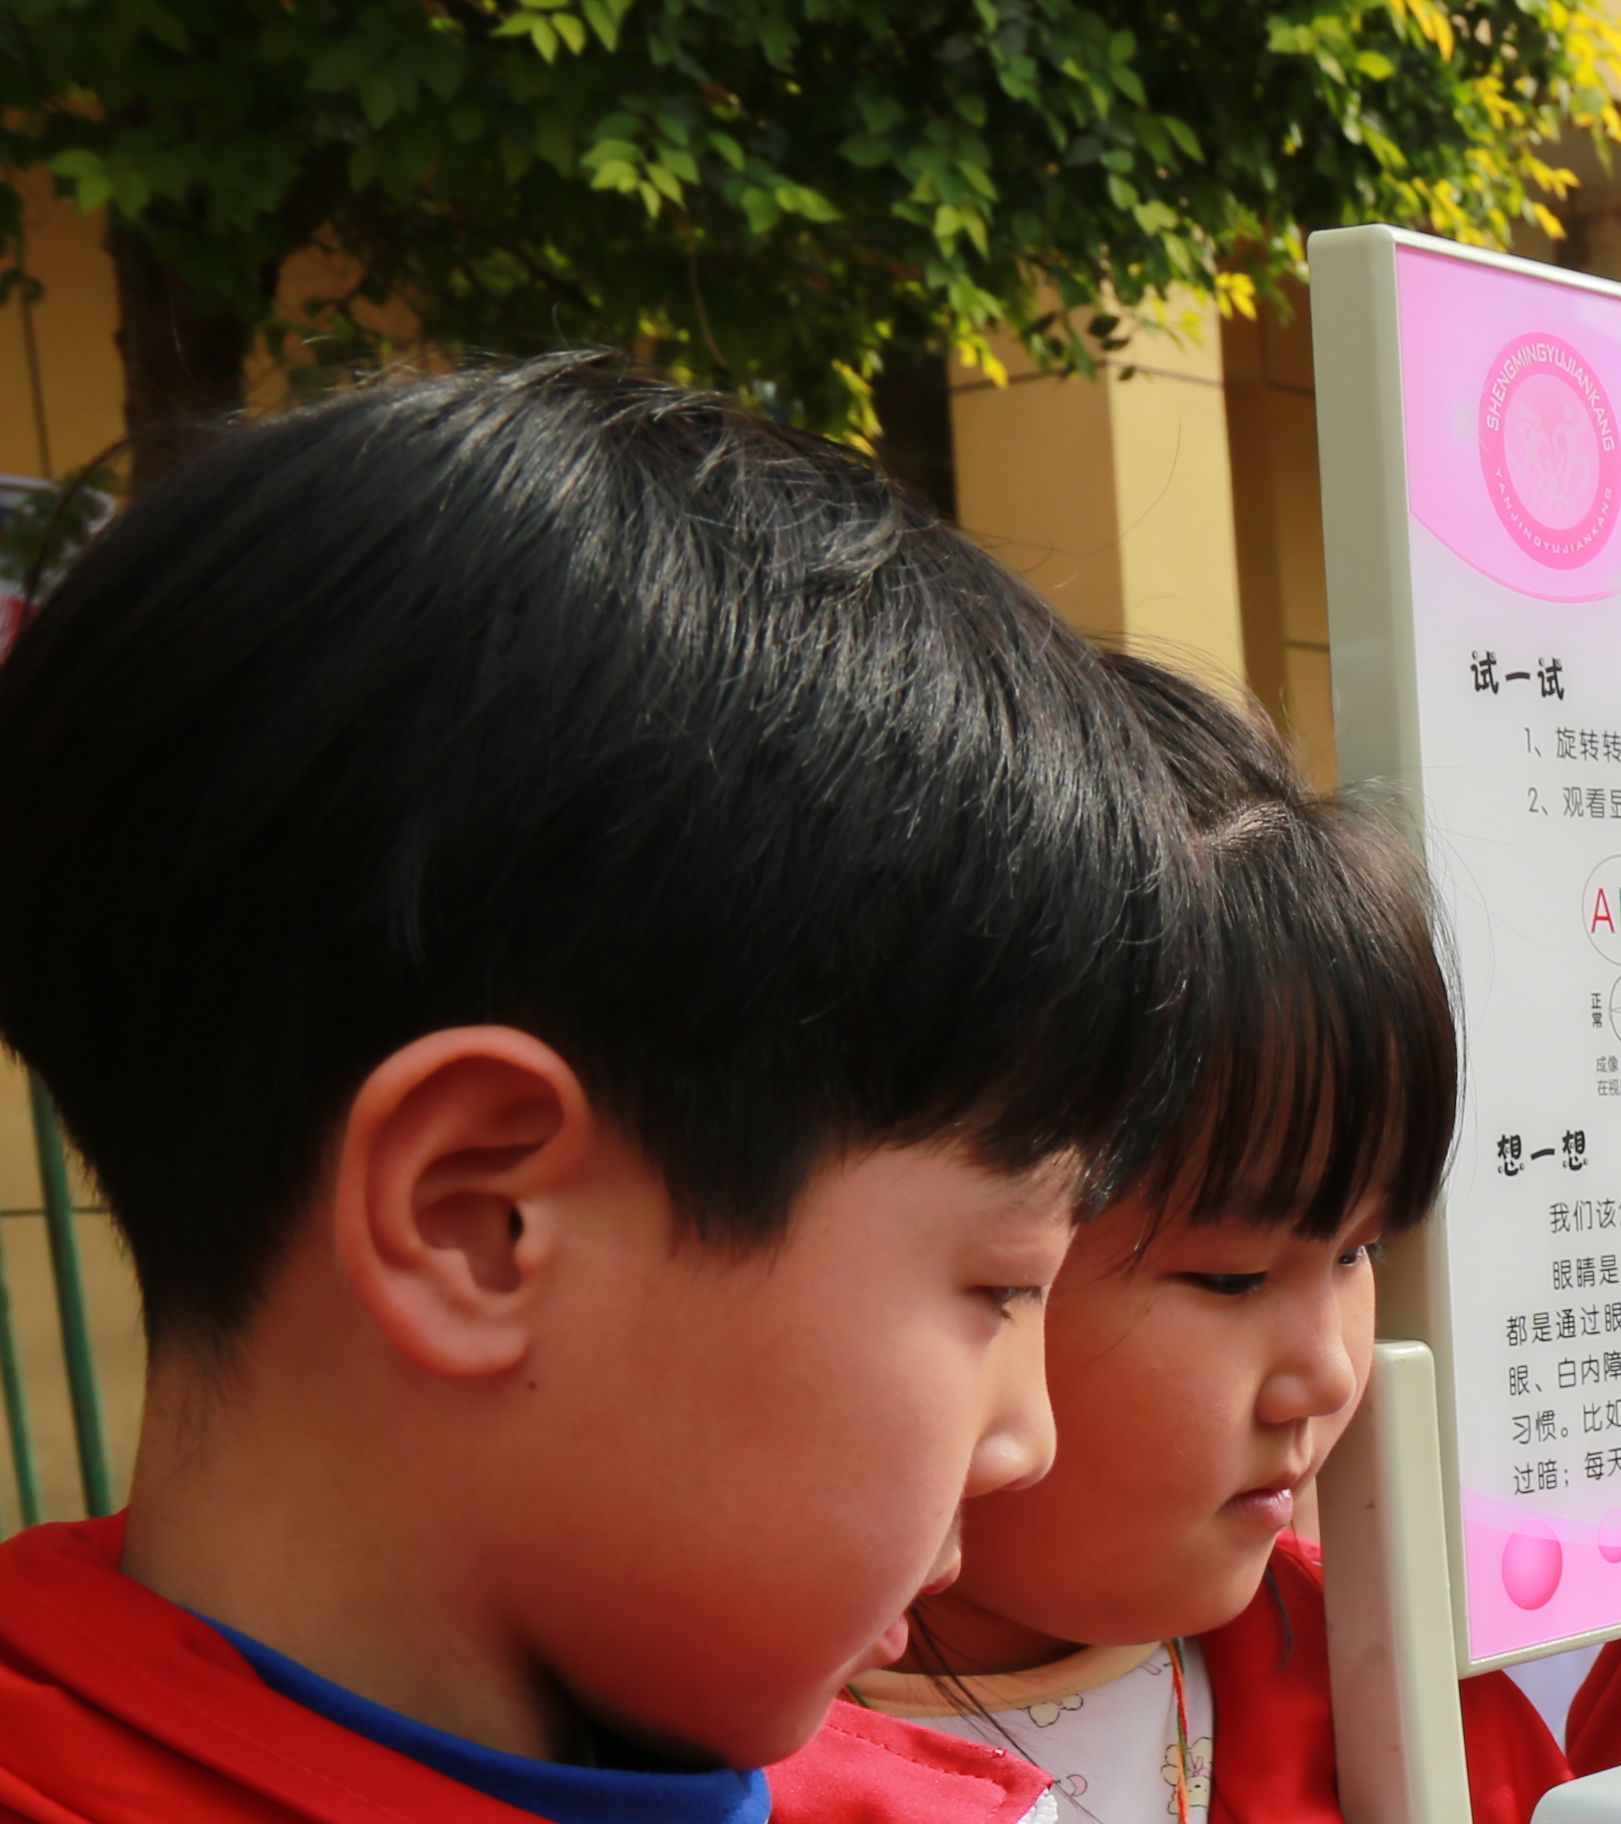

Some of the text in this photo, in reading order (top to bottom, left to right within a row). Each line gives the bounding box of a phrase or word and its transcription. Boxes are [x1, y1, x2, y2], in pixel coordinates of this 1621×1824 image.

[1487, 343, 1616, 452] SHENGMINGYUJIANKANG
[1471, 651, 1564, 700] 试一试
[1497, 1130, 1588, 1177] 想一想
